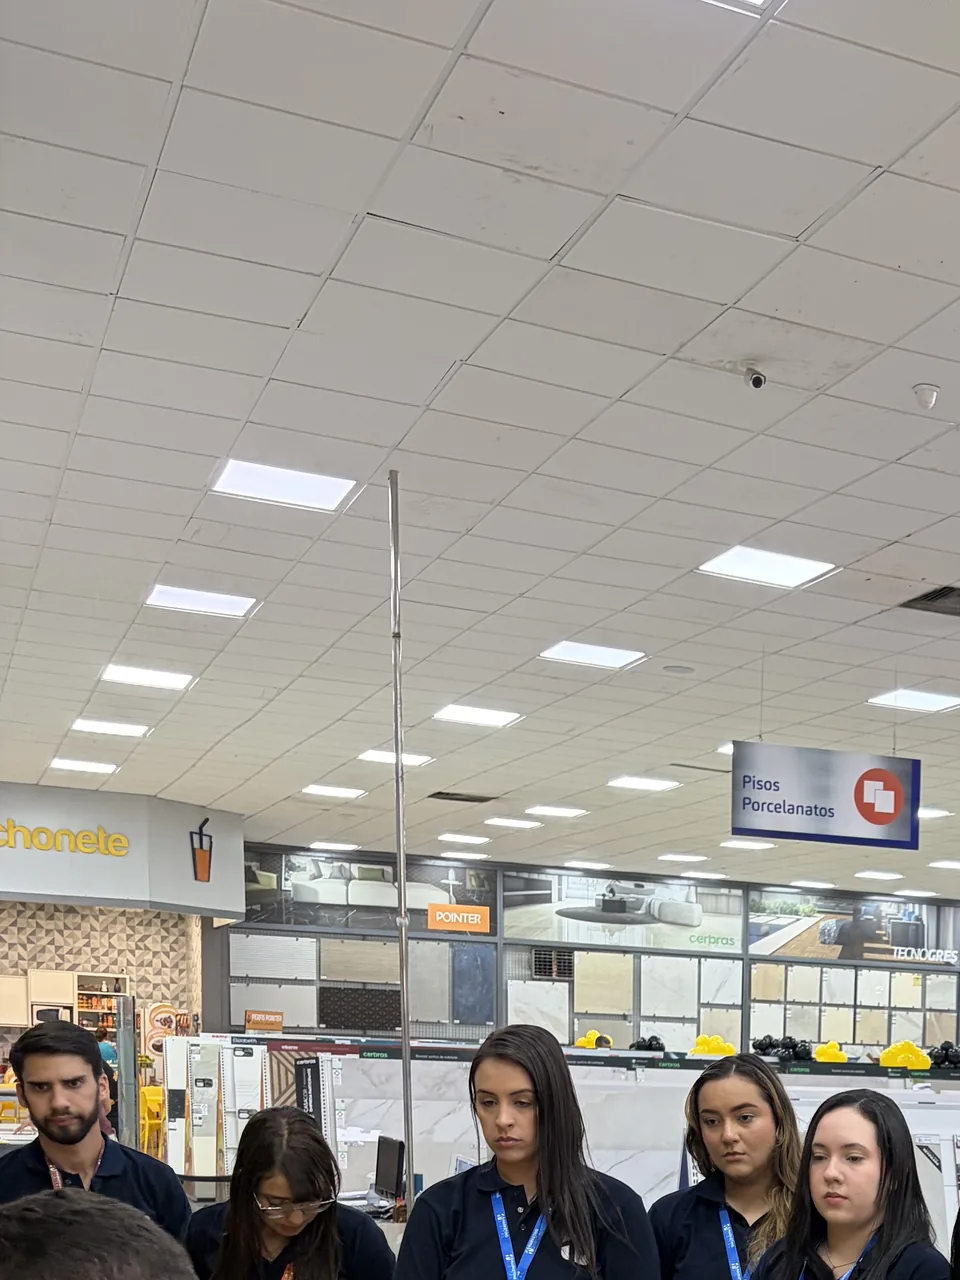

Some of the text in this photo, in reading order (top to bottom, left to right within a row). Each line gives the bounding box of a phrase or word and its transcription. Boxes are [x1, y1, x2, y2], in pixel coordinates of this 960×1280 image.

[742, 775, 780, 793] Pisos
[742, 796, 835, 818] Porcelanatos
[435, 910, 482, 926] POINTER
[689, 933, 735, 947] cerbras
[893, 946, 959, 963] TECNOGRES
